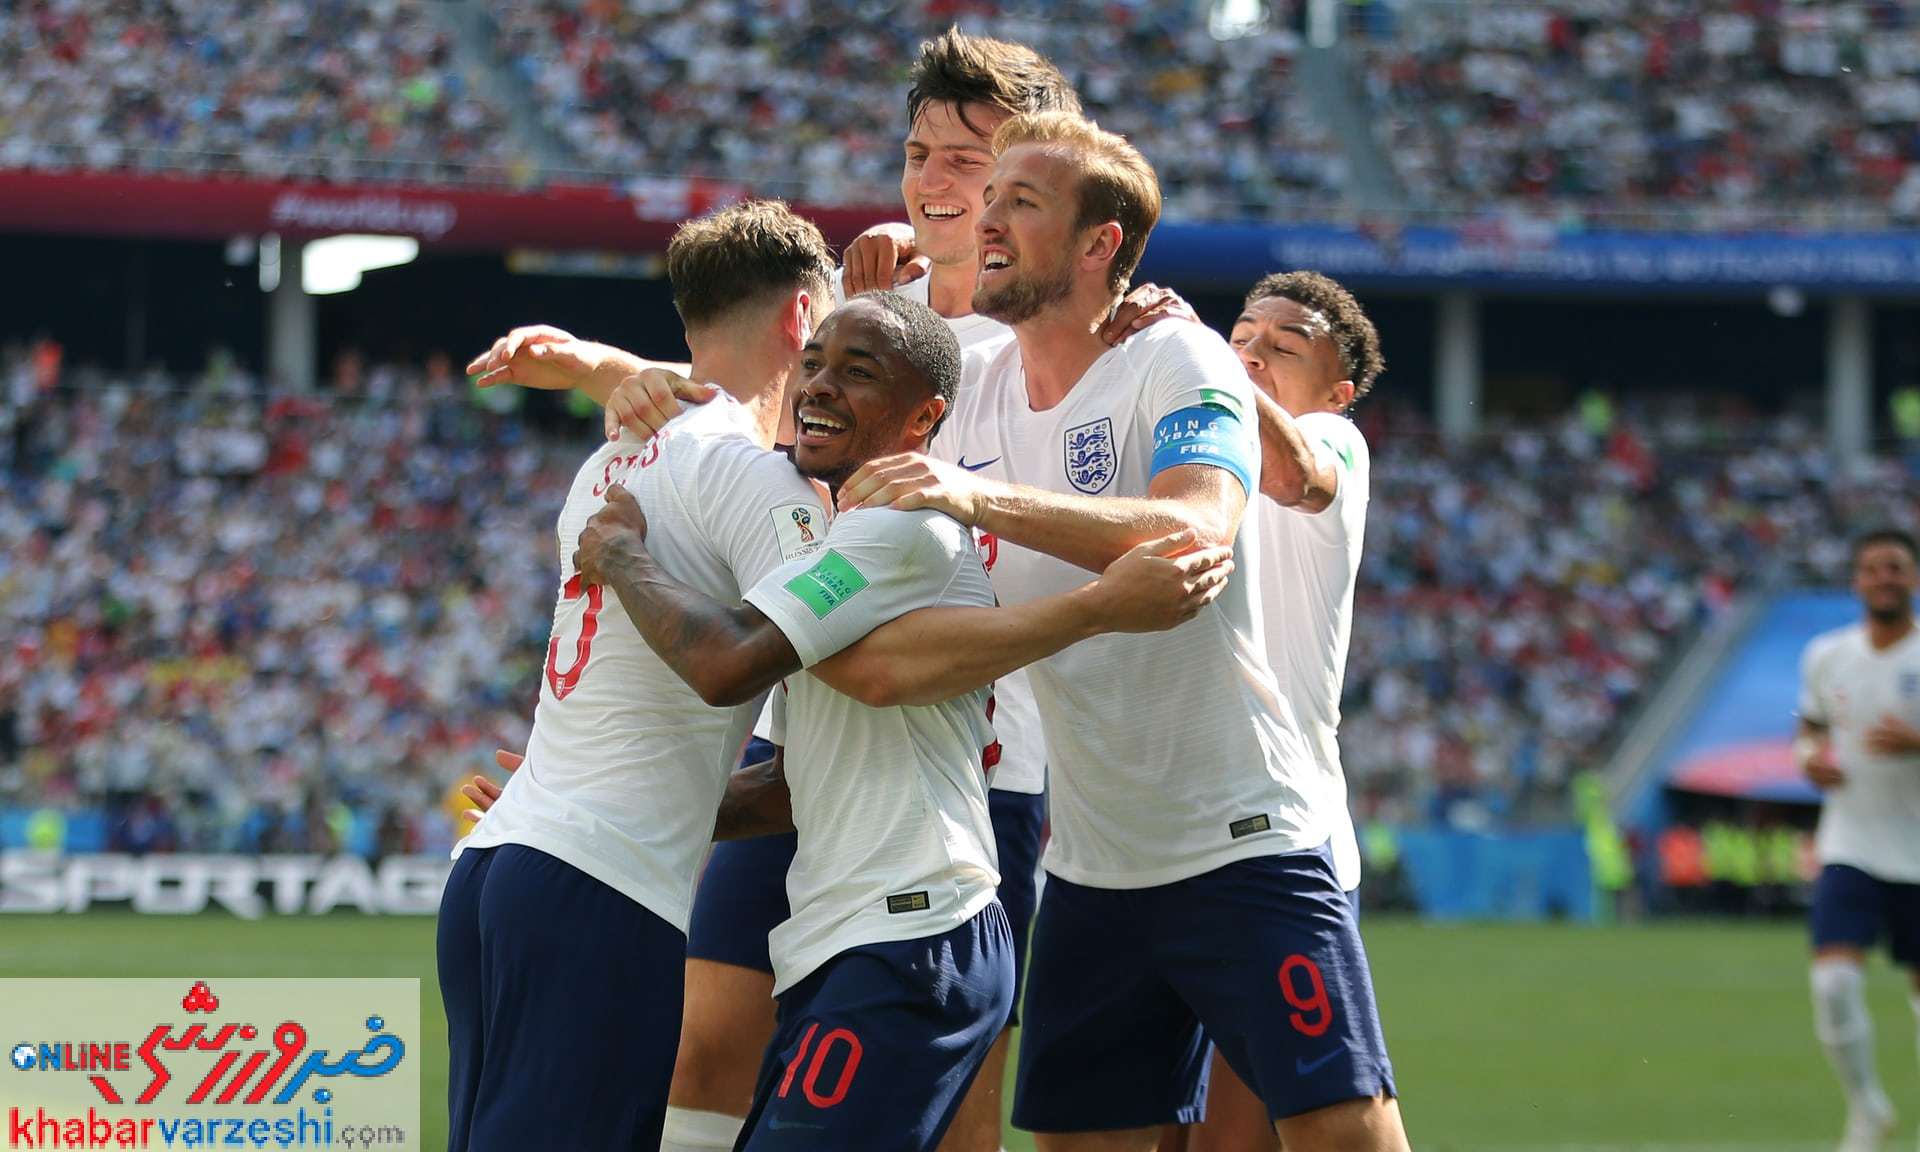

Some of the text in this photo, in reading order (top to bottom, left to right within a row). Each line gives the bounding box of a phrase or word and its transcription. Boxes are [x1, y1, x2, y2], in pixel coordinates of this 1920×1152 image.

[1159, 420, 1219, 437] VING
[1180, 444, 1220, 454] FIFA
[0, 852, 445, 919] SPORTAG
[1278, 954, 1333, 1038] 9
[777, 1022, 864, 1109] 10
